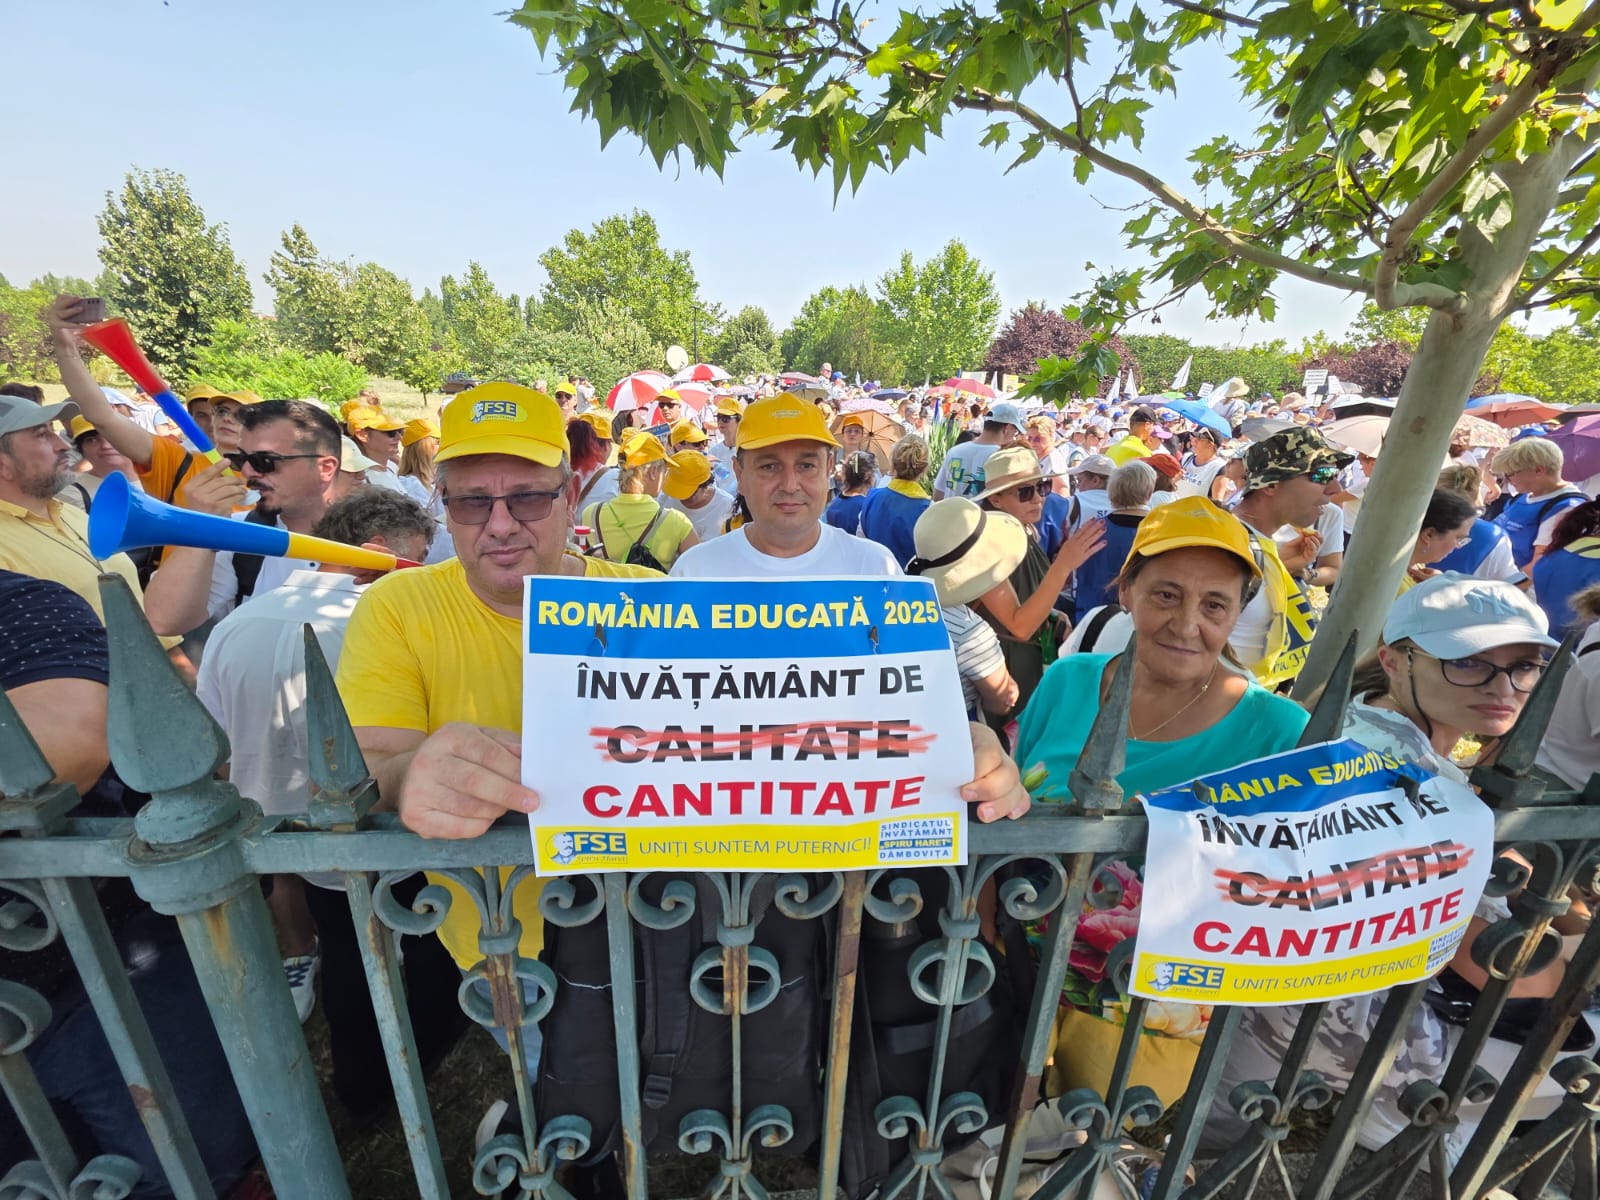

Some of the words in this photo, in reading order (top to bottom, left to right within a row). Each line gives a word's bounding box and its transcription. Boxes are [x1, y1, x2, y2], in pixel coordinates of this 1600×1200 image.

[484, 402, 516, 414] FSE
[538, 597, 700, 629] ROMÂNIA
[711, 596, 870, 629] EDUCATĂ
[884, 601, 939, 625] 2025
[577, 662, 865, 710] ÎNVĂȚĂMÂNT
[879, 665, 924, 693] DE
[607, 720, 911, 763] CALITATE
[583, 777, 925, 819] CANTITATE
[881, 819, 951, 831] SINDICATUL
[574, 834, 626, 852] FSE
[639, 841, 687, 857] UNIȚI
[693, 840, 770, 854] SUNTEM
[775, 837, 872, 855] PUTERNICI!
[1229, 839, 1459, 913] CALITATE
[1193, 888, 1465, 958] CANTITATE
[1172, 965, 1223, 986] FSE
[1233, 977, 1280, 993] UNIȚI
[1282, 971, 1348, 990] SUNTEM
